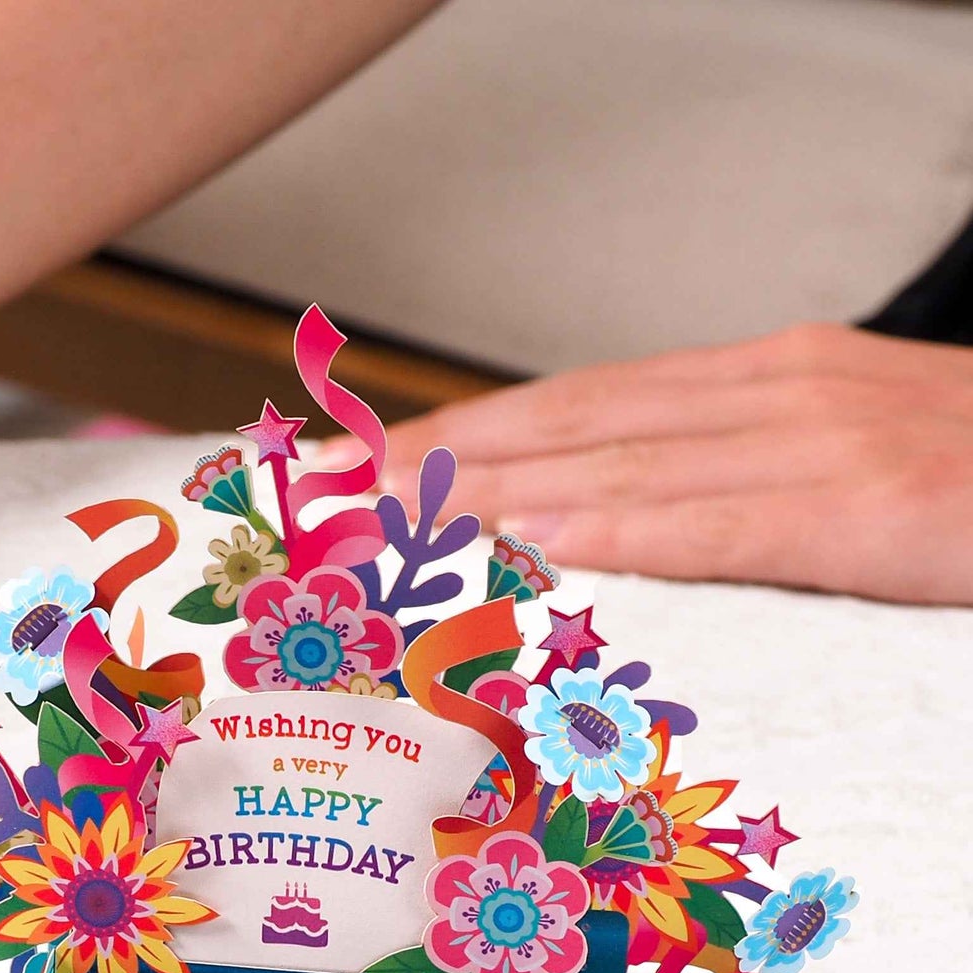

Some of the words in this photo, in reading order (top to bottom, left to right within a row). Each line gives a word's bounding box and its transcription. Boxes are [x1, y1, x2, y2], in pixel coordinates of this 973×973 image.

[211, 713, 355, 750] Wishing
[363, 725, 422, 763] you
[273, 758, 285, 773] a
[291, 757, 348, 781] very
[233, 786, 383, 826] HAPPY
[184, 832, 415, 884] BIRTHDAY
